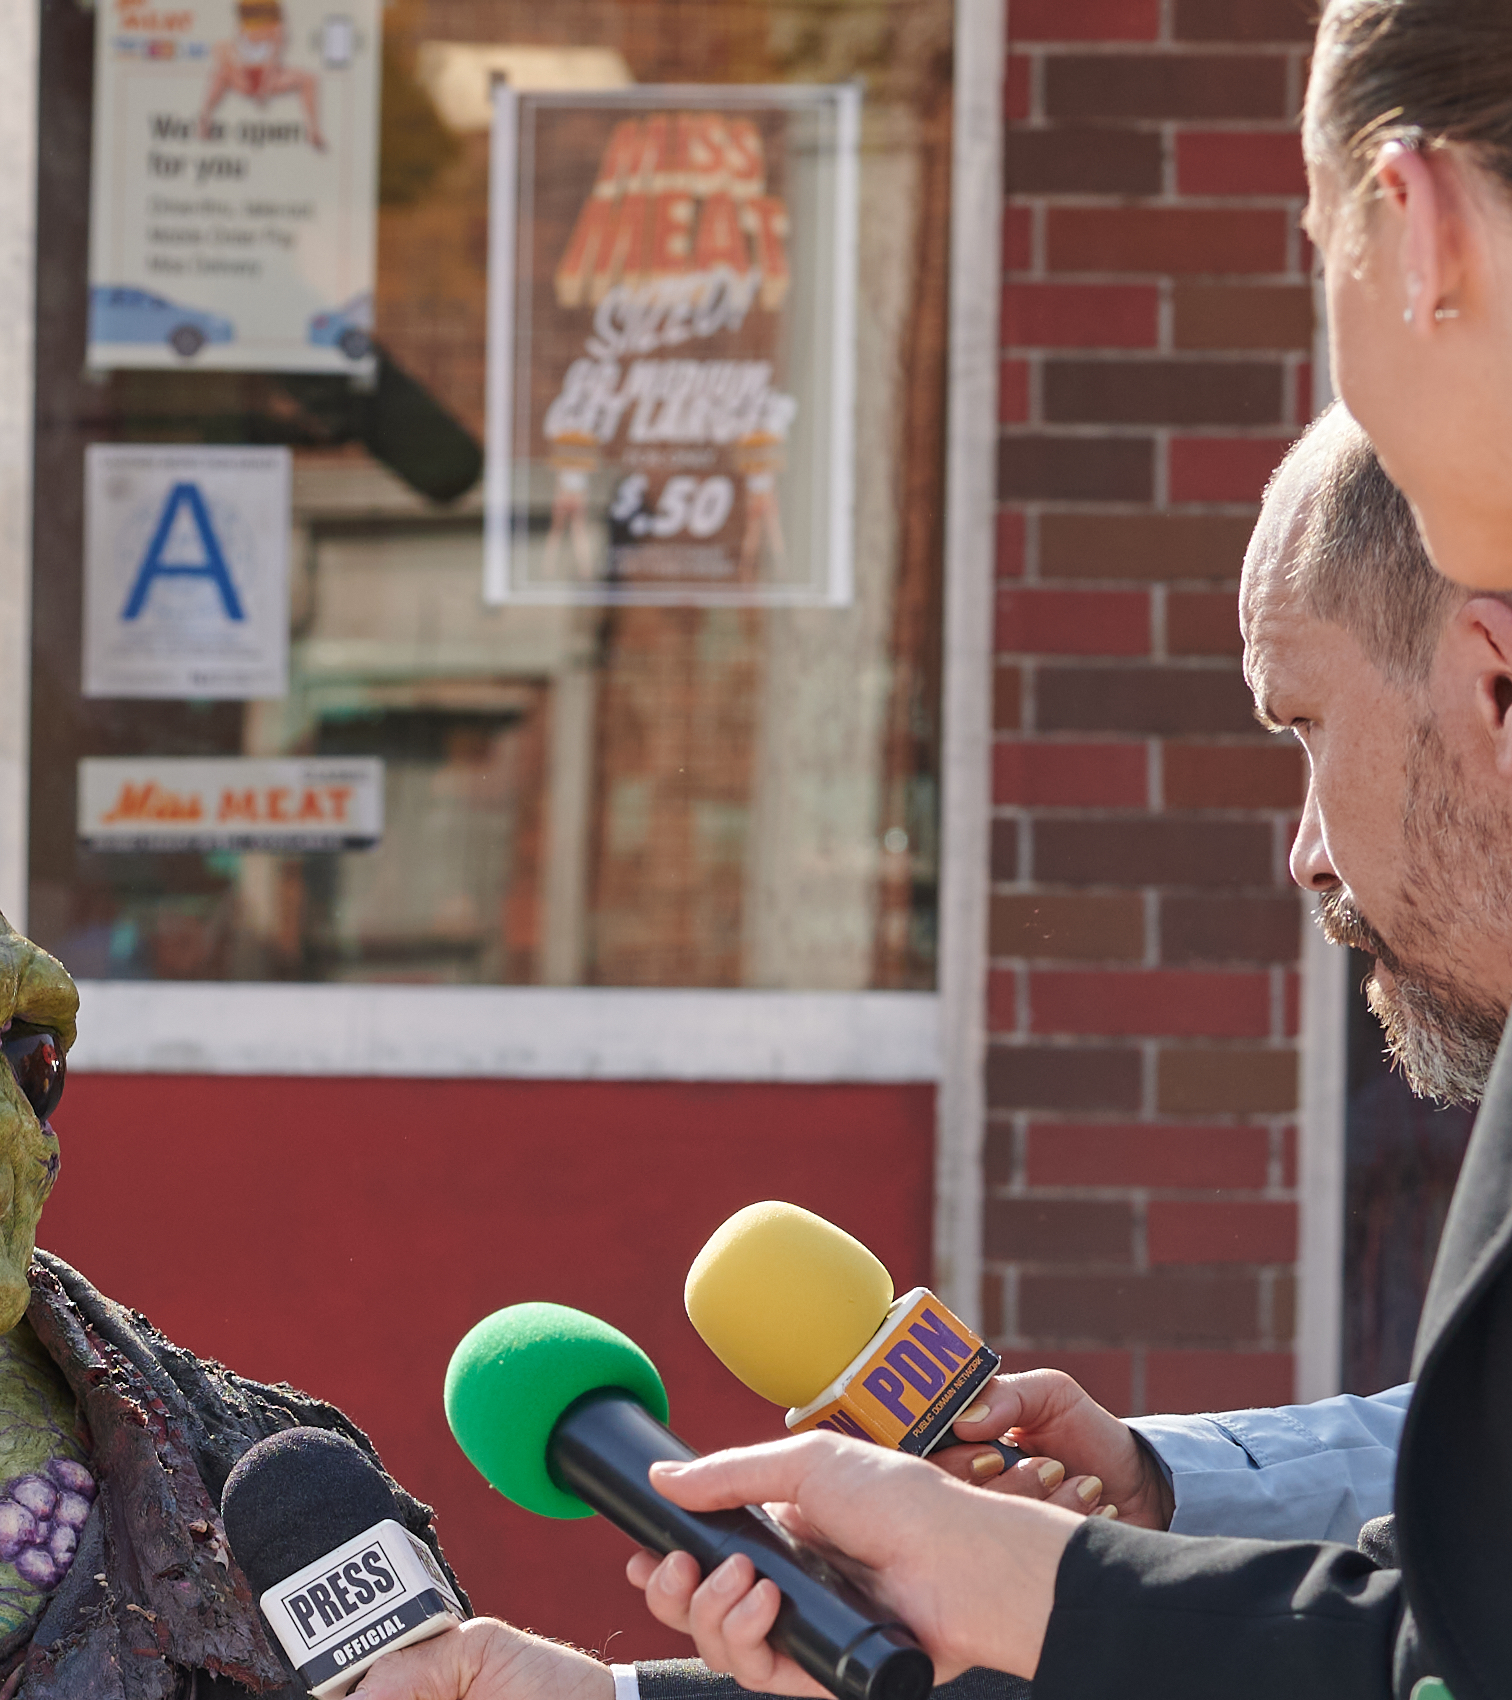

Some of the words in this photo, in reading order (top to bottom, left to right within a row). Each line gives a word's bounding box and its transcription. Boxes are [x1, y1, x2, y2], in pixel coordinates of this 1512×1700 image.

[195, 155, 248, 186] you
[592, 114, 765, 194] MISS
[556, 190, 791, 304] MEAT
[120, 481, 249, 624] A
[216, 786, 356, 824] MEAT
[862, 1307, 974, 1428] PDN
[912, 1410, 935, 1438] PUBLIC
[932, 1386, 957, 1415] DOMAIN
[952, 1355, 984, 1391] NETWORK
[288, 1550, 396, 1640] PRESS
[332, 1614, 406, 1667] OFFICIAL
